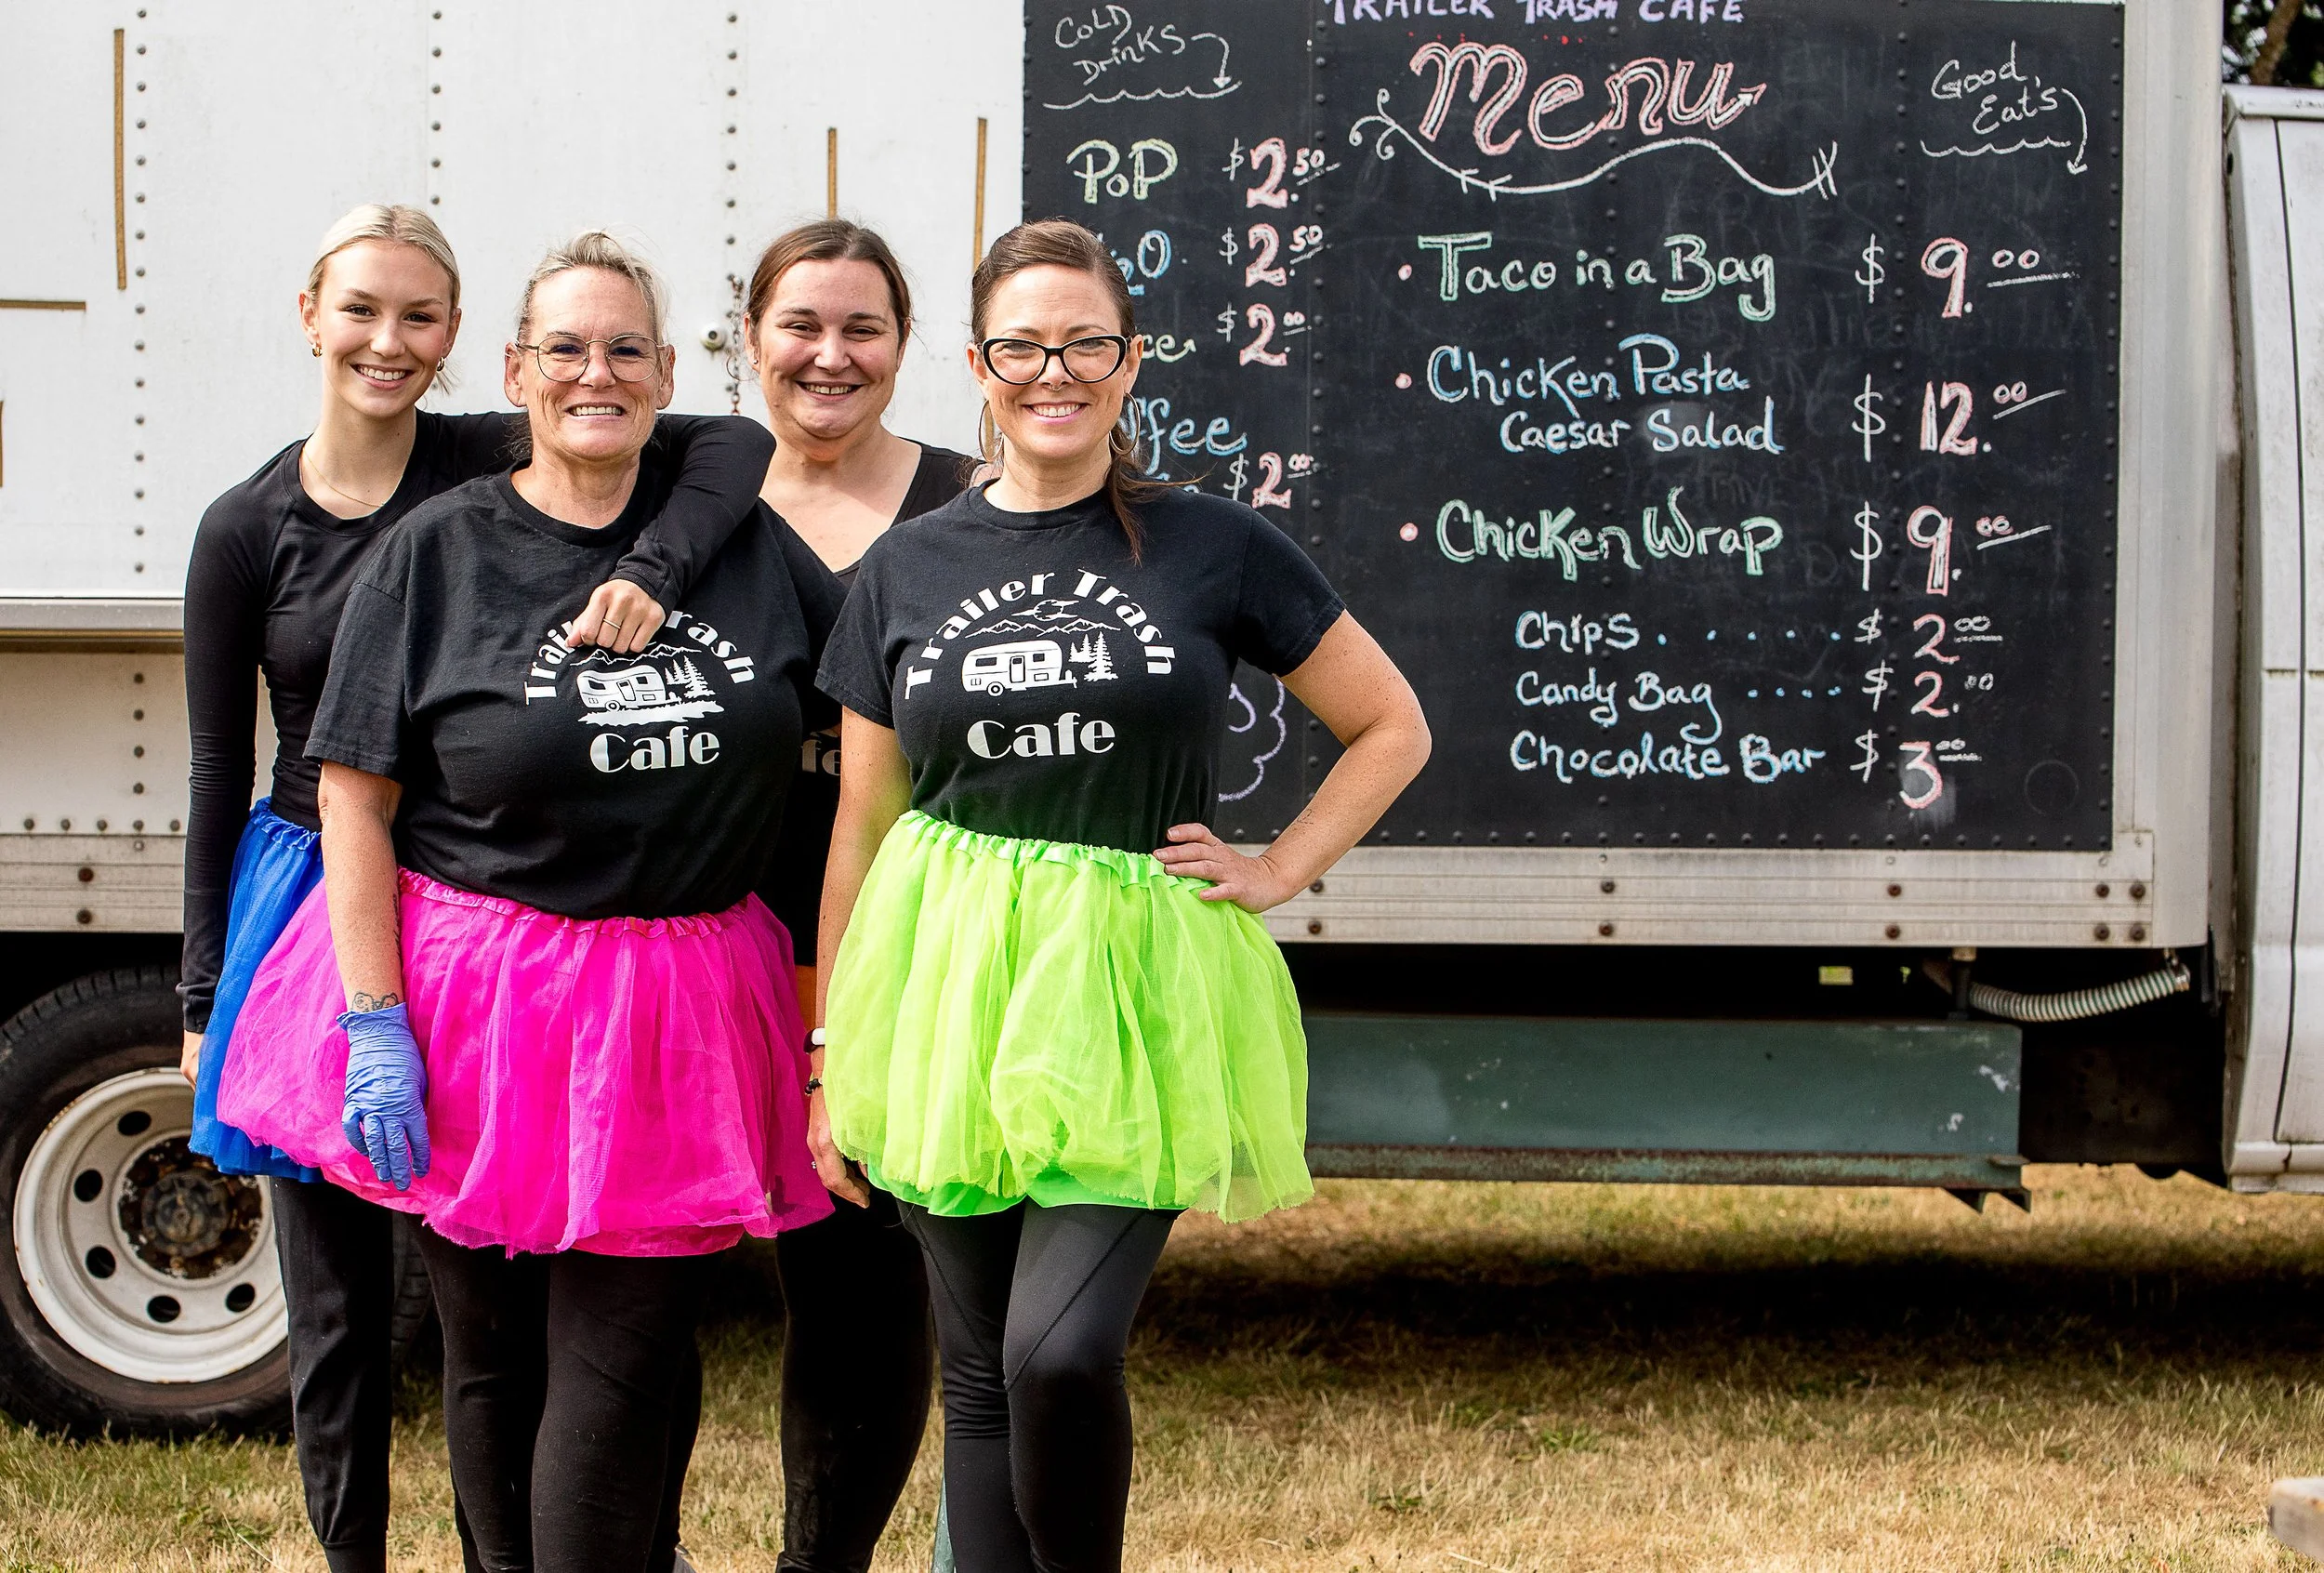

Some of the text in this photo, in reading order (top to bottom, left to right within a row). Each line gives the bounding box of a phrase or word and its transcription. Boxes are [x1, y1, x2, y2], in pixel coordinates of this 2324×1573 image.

[1409, 42, 1766, 156] Menu
[1418, 231, 1557, 301] Taco
[1577, 249, 1615, 289] in
[1625, 258, 1657, 284] a
[1661, 233, 1776, 322] Bag
[1618, 333, 1750, 395] Pasta
[1499, 396, 1786, 455] Caesar Salad
[1643, 486, 1784, 575] Wrap
[666, 610, 755, 684] rash
[905, 568, 1175, 699] Trailer Trash
[967, 712, 1116, 759] Cafe
[1515, 668, 1618, 728] Candy
[1629, 672, 1723, 745] Bag
[590, 725, 720, 773] Cafe
[800, 739, 841, 775] fe
[1511, 730, 1730, 784] Chocolate
[1739, 734, 1827, 784] Bar
